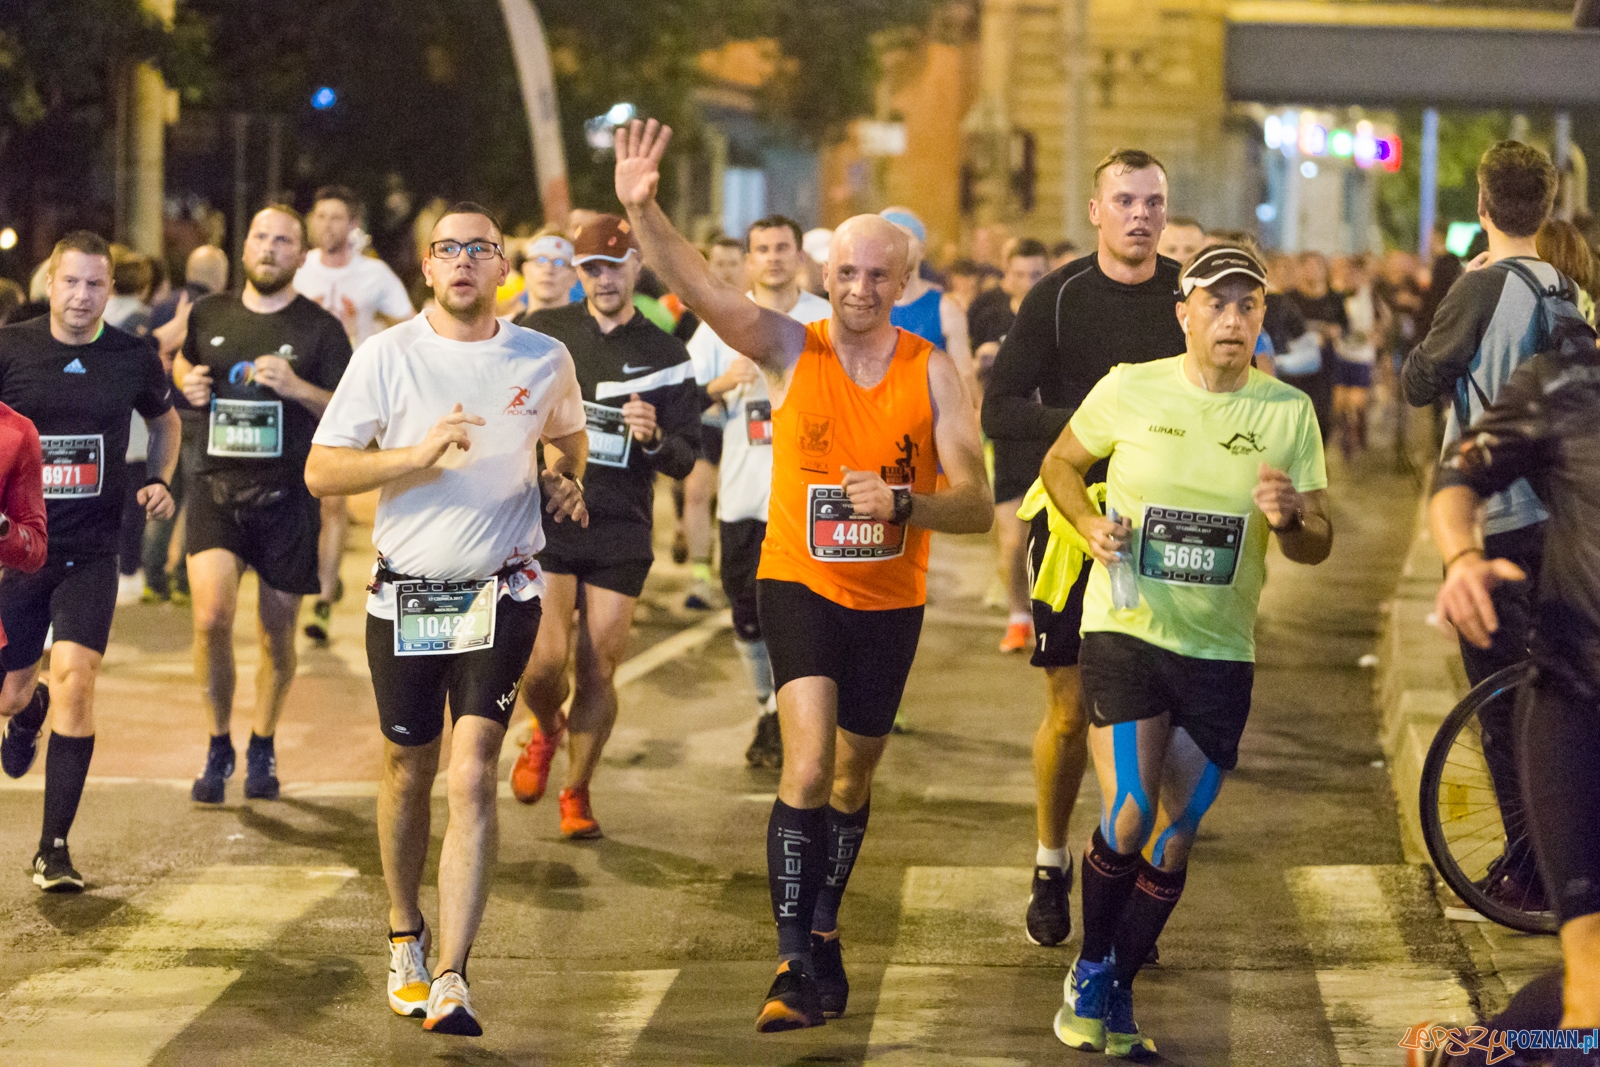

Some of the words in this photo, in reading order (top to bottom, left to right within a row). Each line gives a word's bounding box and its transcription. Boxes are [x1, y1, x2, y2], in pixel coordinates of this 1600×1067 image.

[226, 426, 261, 445] 3431
[42, 465, 81, 486] 6971
[832, 522, 885, 545] 4408
[1163, 543, 1216, 571] 5663
[416, 614, 476, 638] 10422
[1039, 632, 1047, 652] 1
[777, 826, 812, 918] kalenji
